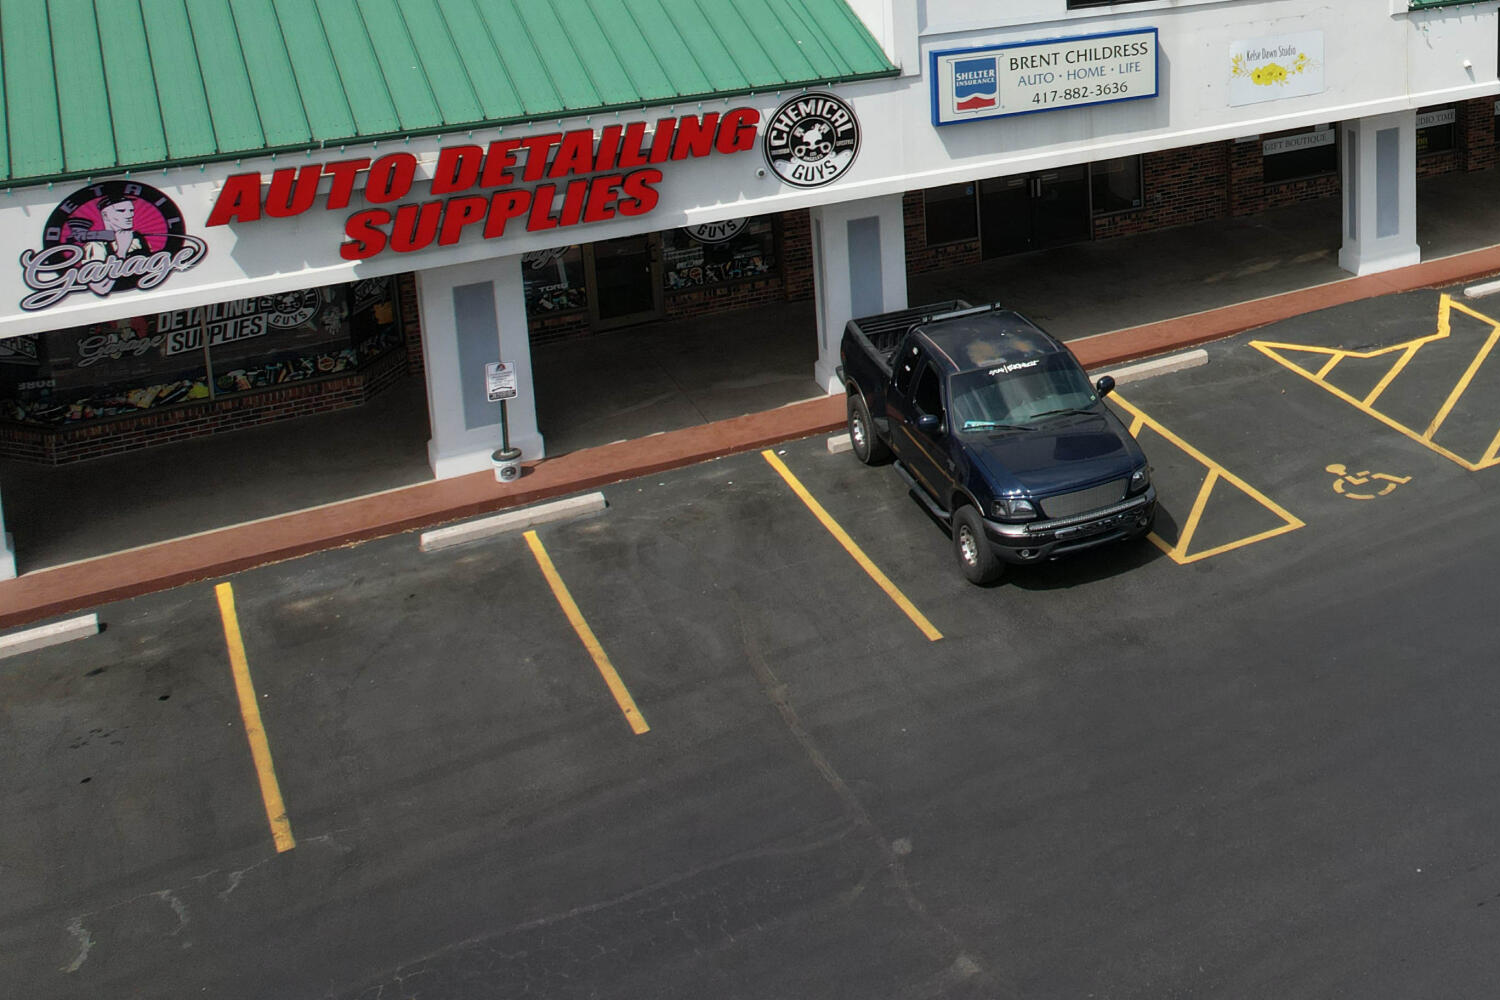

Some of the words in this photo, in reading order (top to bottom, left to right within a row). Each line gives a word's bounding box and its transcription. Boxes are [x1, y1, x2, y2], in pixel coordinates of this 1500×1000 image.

[1009, 52, 1060, 71] BRENT
[1065, 42, 1149, 64] CHILDRESS
[1278, 44, 1297, 57] Studio
[955, 69, 996, 81] SHELTER
[956, 78, 996, 87] INSURANCE
[1017, 72, 1055, 87] AUTO
[1067, 65, 1106, 81] HOME
[1119, 61, 1141, 74] LIFE
[1032, 81, 1128, 104] 417-882-3636
[770, 98, 853, 147] CHEMICAL
[1264, 141, 1284, 152] GIFT
[1285, 133, 1328, 148] BOUTIQUE
[205, 152, 417, 228] AUTO
[431, 107, 761, 196] DETAILING
[791, 160, 838, 181] GUYS
[46, 183, 181, 241] DETAIL
[340, 168, 663, 261] SUPPLIES
[697, 220, 738, 238] GUYS
[20, 240, 208, 311] Garage
[157, 297, 256, 333] DETAILING
[272, 310, 308, 326] GUYS
[78, 334, 167, 368] Garage
